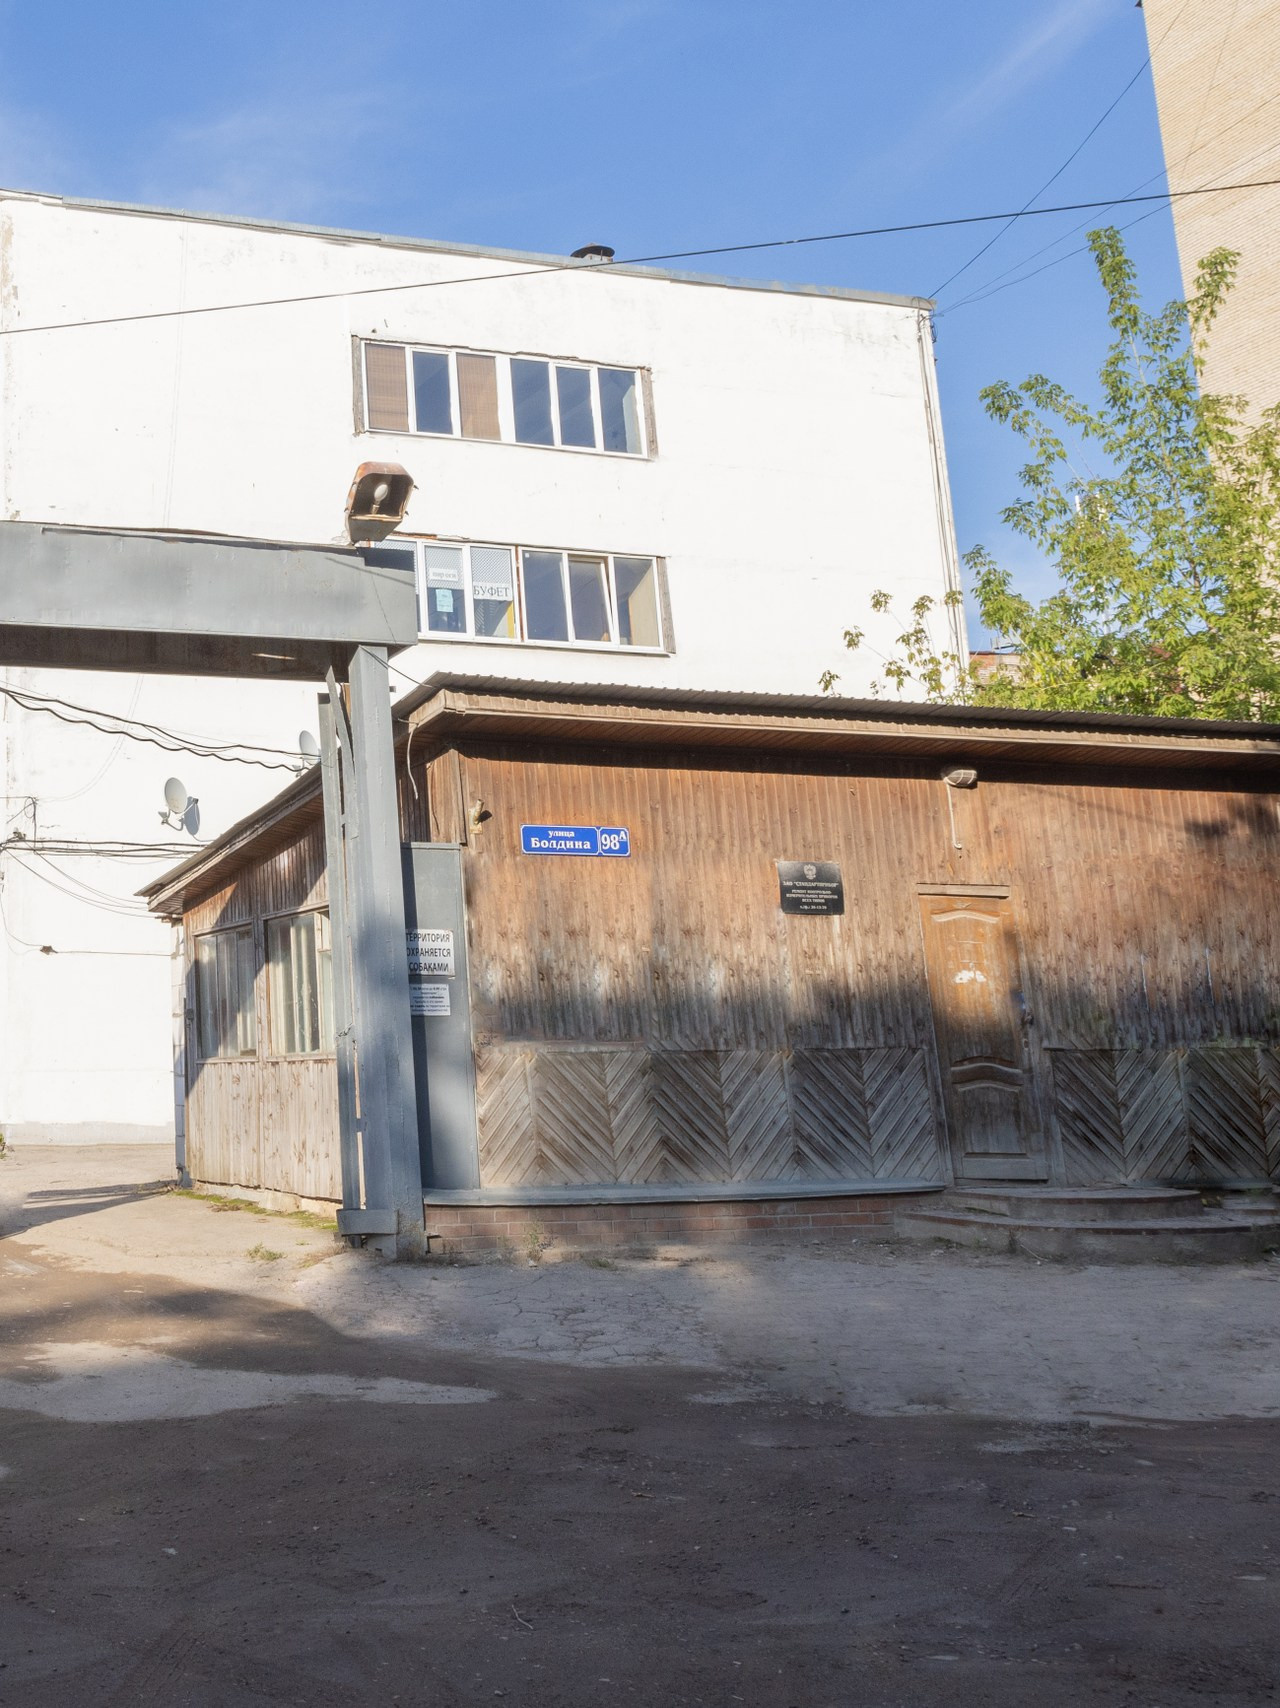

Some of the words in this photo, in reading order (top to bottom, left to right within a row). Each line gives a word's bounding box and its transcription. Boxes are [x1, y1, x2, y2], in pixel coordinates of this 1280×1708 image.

[473, 584, 510, 597] БУФЕТ
[548, 830, 575, 838] улица
[530, 837, 591, 851] Болдина
[405, 932, 450, 943] ТЕРРИТОРИЯ
[406, 947, 451, 957] ОХРАНЯЕТСЯ
[408, 962, 449, 972] СОБАКАМИ
